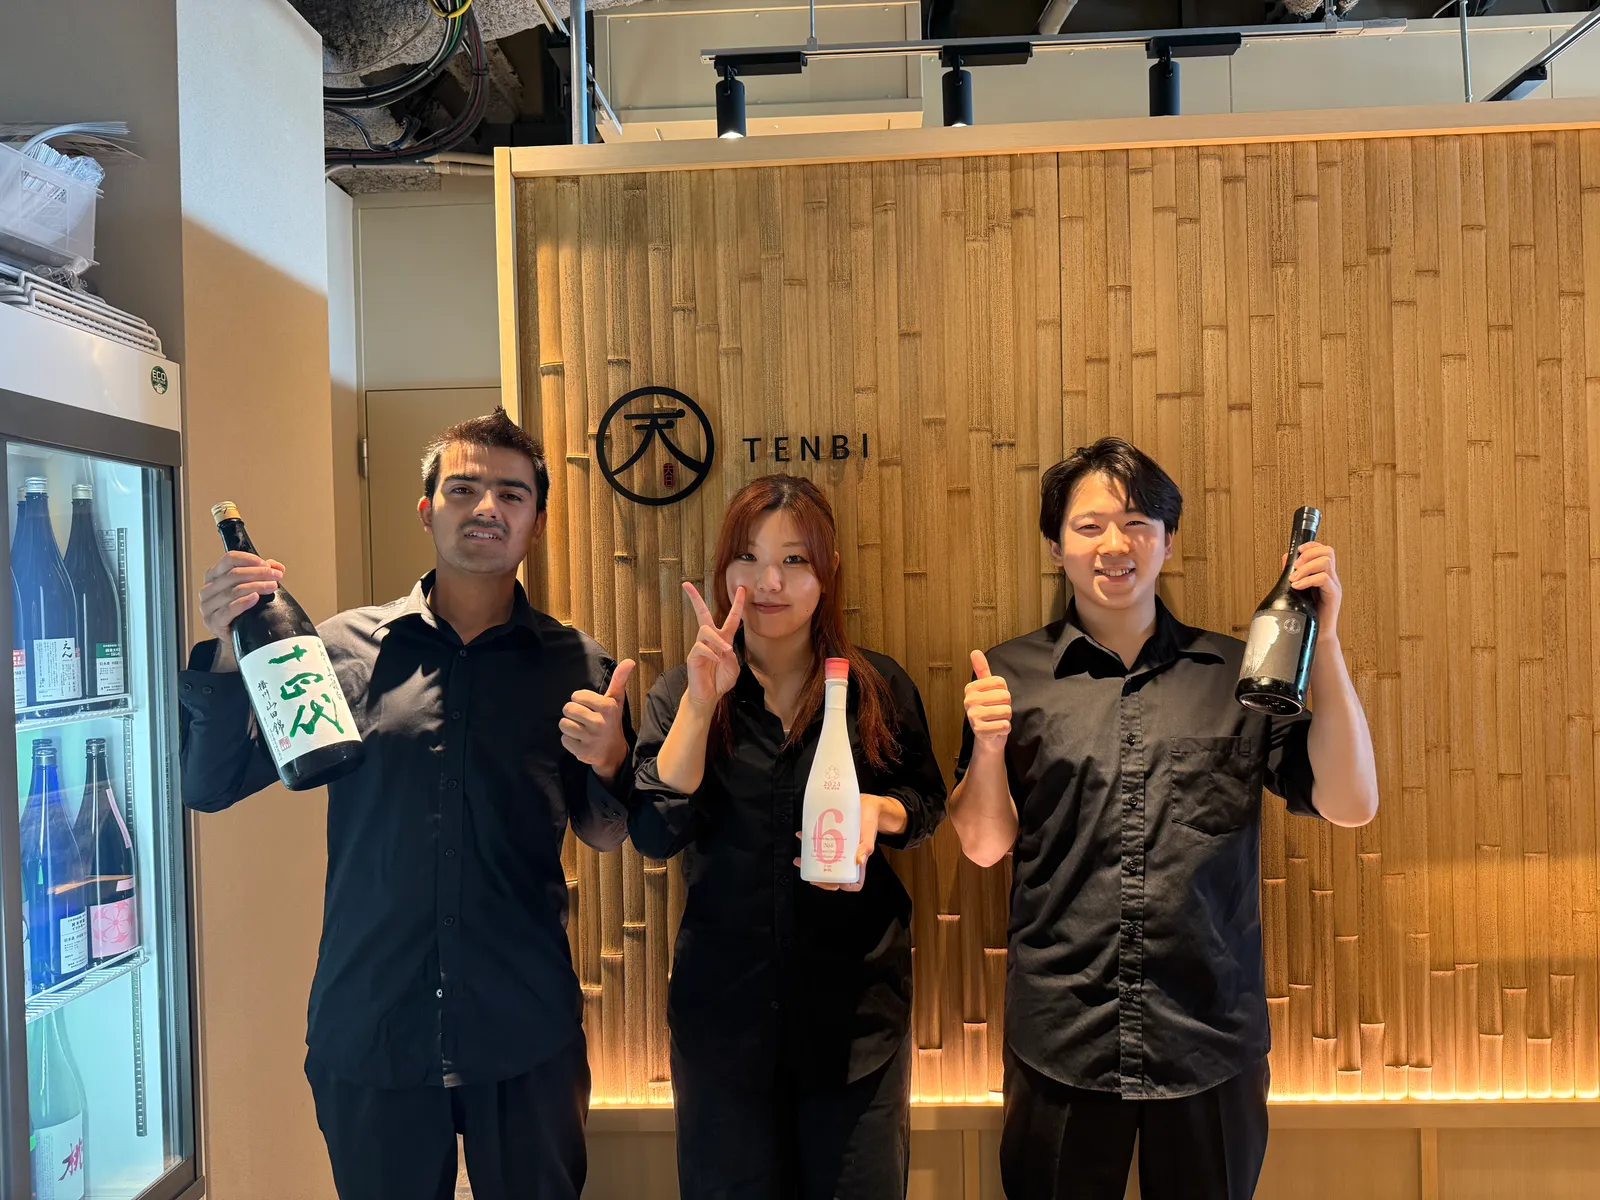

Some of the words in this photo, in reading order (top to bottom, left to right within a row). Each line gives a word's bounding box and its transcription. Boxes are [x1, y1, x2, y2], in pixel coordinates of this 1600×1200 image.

[742, 433, 869, 463] TENBI
[268, 644, 345, 738] 十四代
[813, 808, 845, 865] 6
